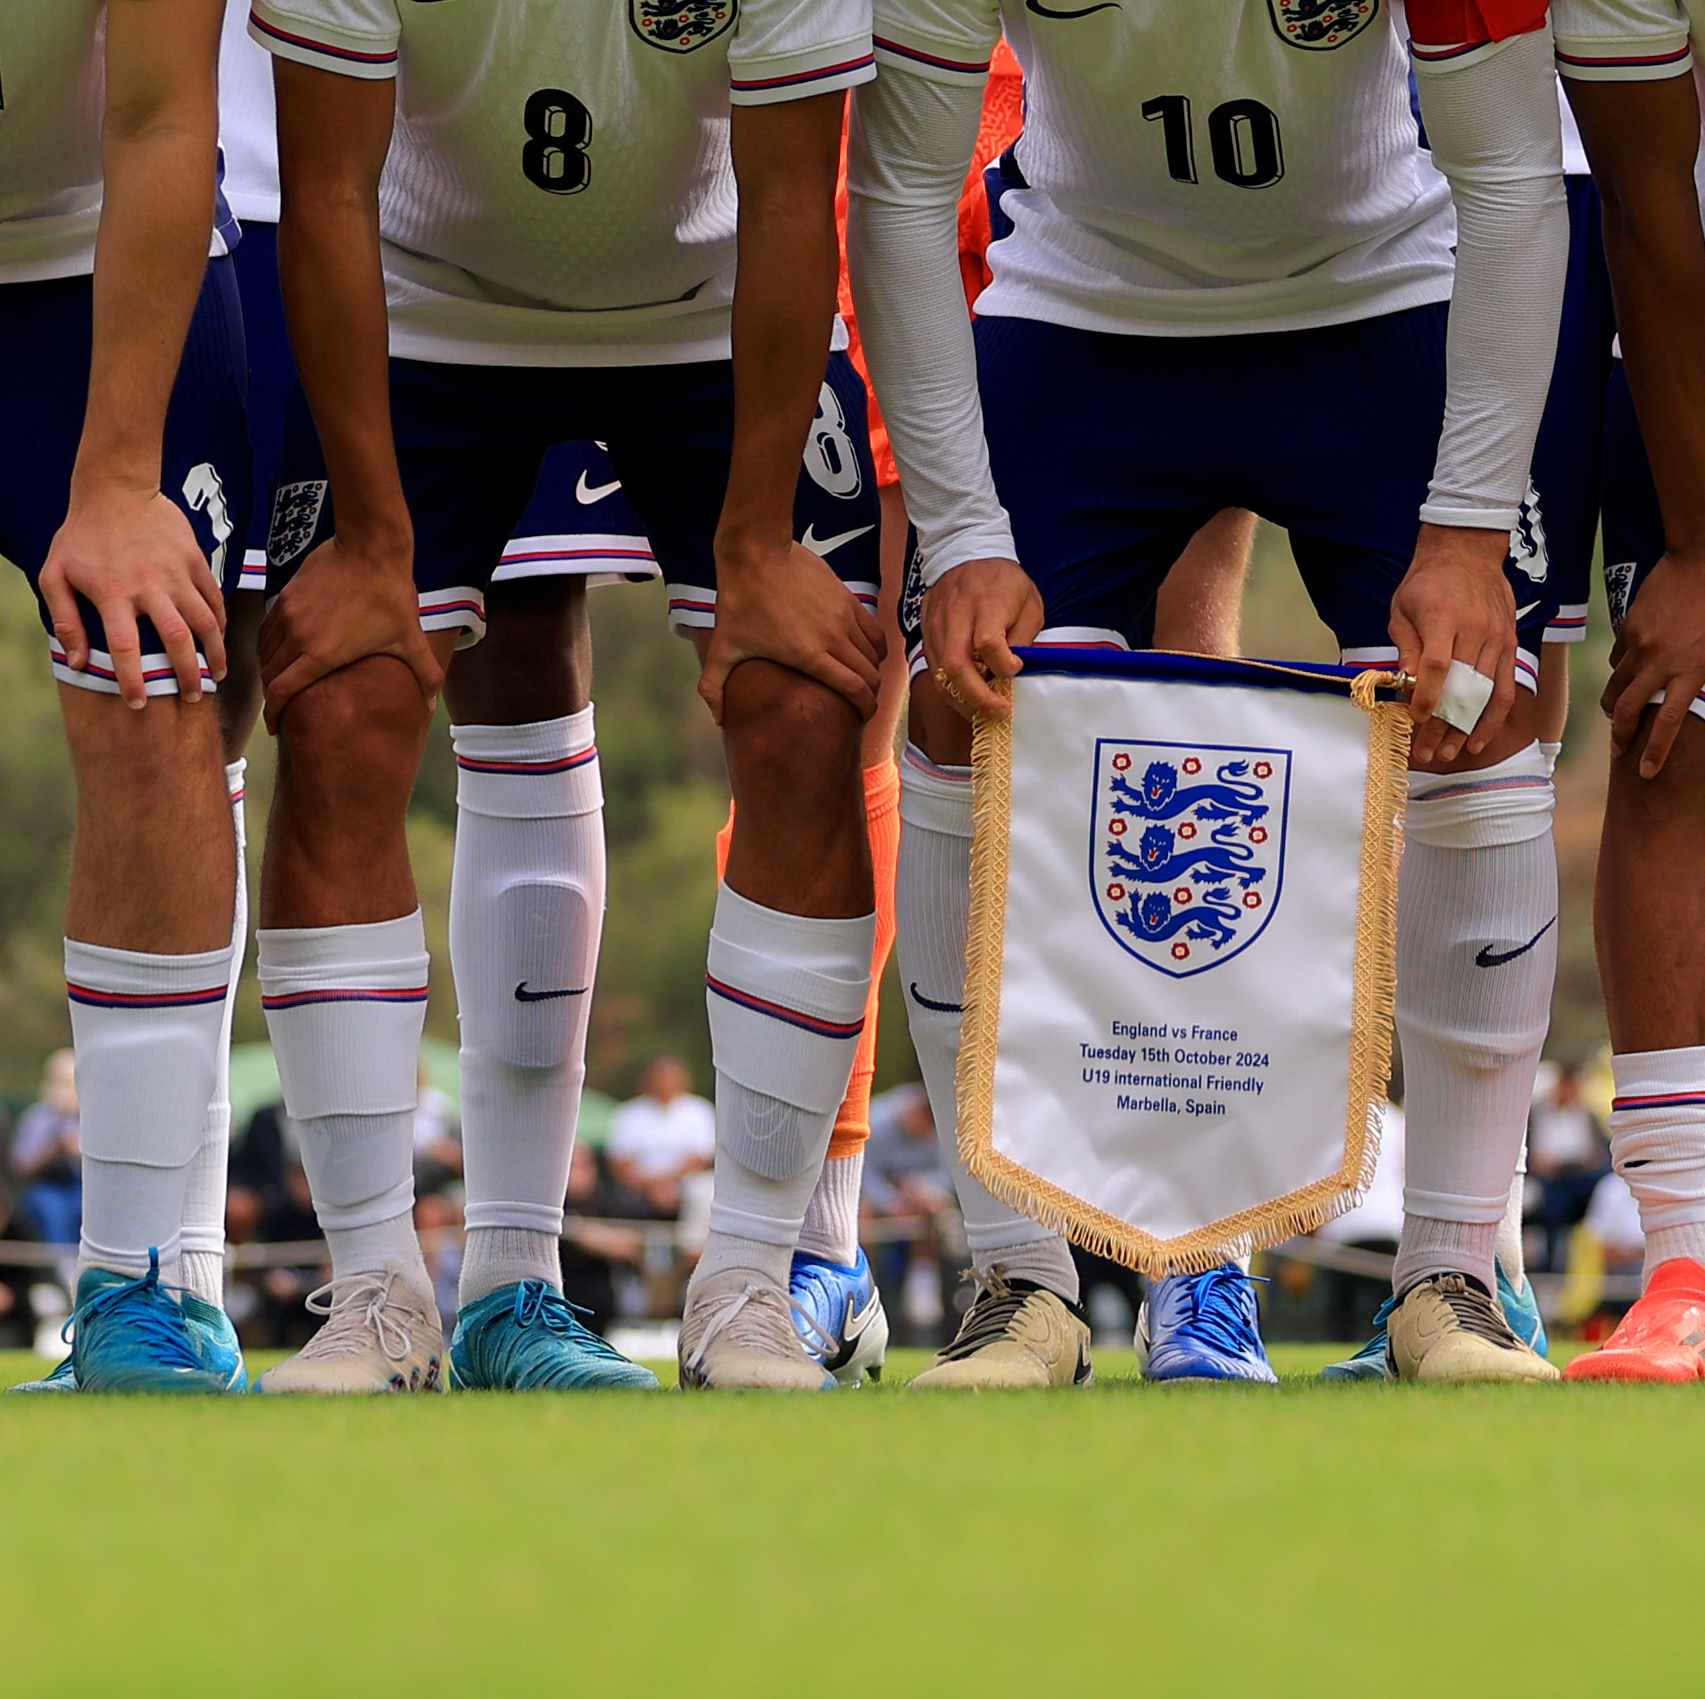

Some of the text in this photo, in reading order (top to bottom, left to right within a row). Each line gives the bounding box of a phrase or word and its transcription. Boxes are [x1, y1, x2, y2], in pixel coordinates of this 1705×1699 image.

[520, 87, 593, 197] 8
[1140, 93, 1287, 190] 10
[802, 381, 862, 500] 8
[1112, 1021, 1238, 1041] England vs France
[1080, 1043, 1270, 1067] Tuesday 15th October 2024
[1082, 1068, 1264, 1095] U19 international Friendly
[1117, 1095, 1226, 1116] Marbella, Spain
